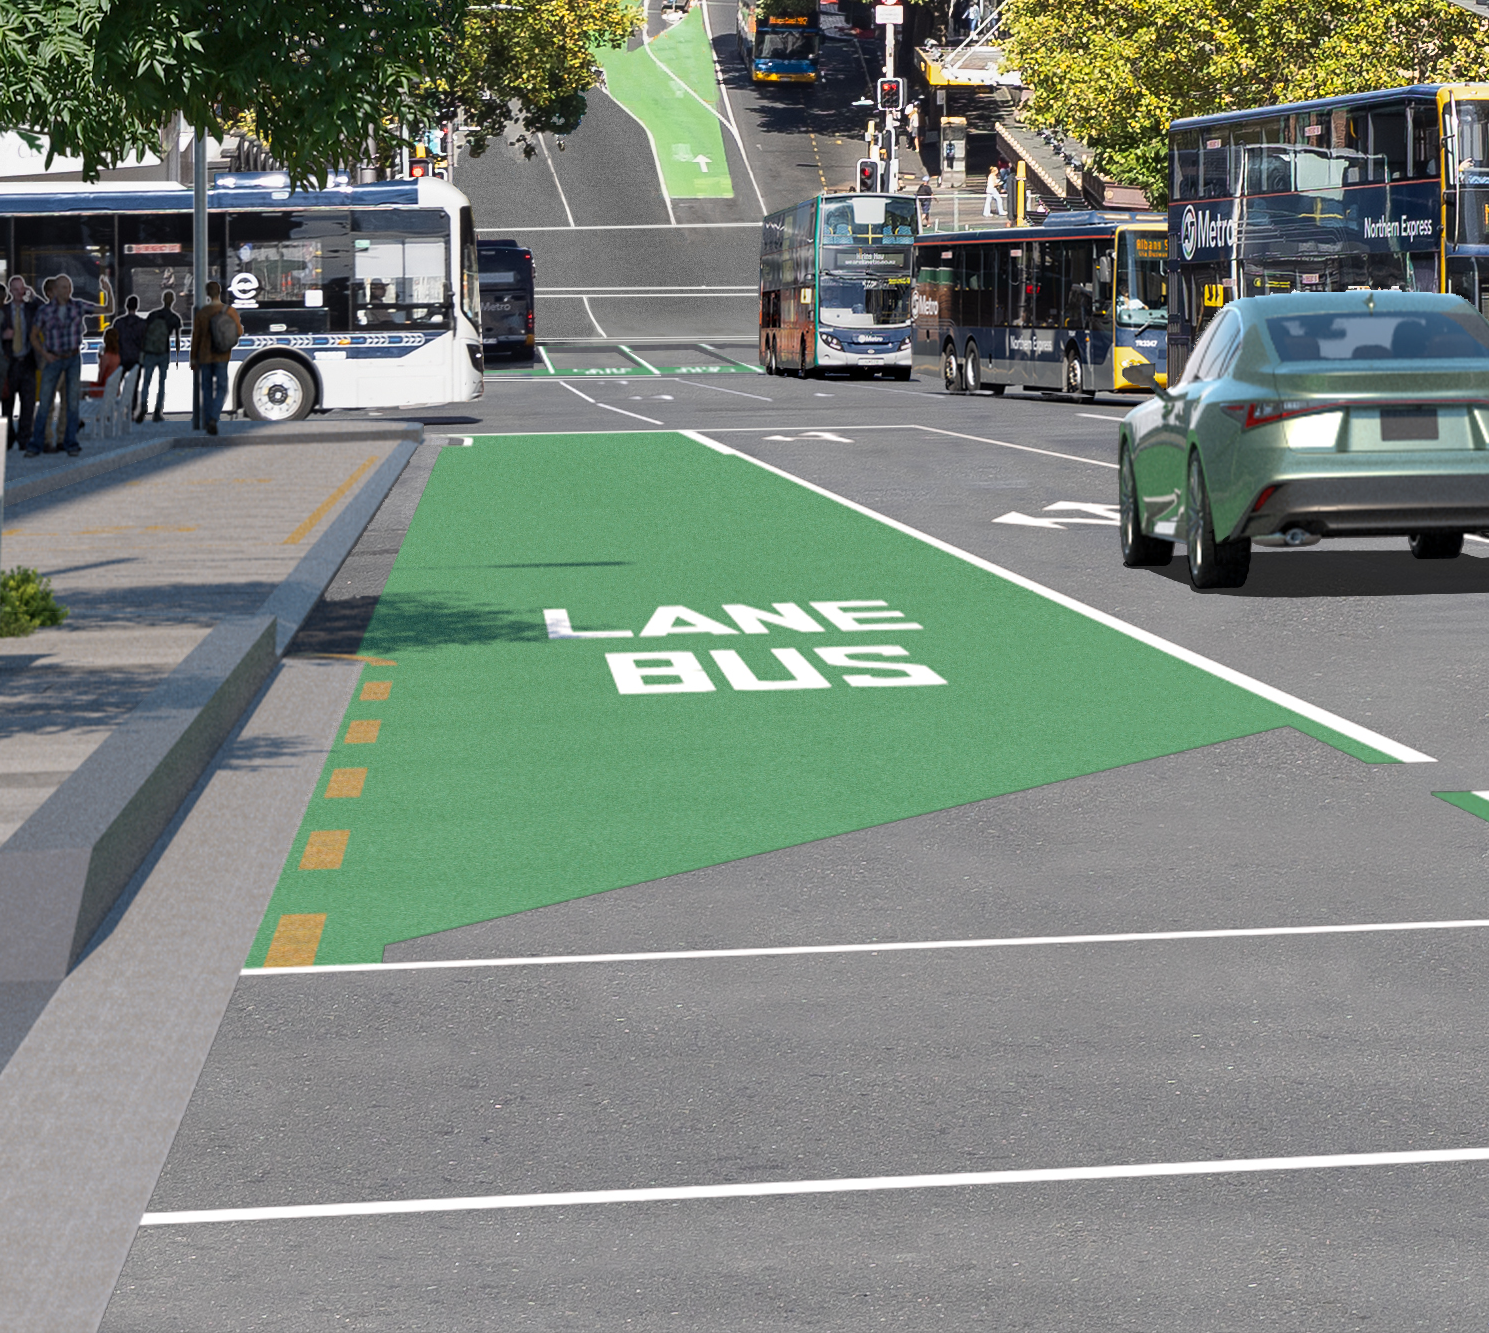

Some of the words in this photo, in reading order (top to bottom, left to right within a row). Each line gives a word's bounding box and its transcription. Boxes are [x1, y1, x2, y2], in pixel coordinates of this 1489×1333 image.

[1197, 210, 1234, 248] Metro
[1364, 216, 1399, 239] Northern
[1401, 215, 1432, 241] Express
[919, 295, 939, 316] Metro
[1032, 336, 1052, 353] Express
[543, 599, 924, 641] LANE
[604, 644, 949, 696] BUS
